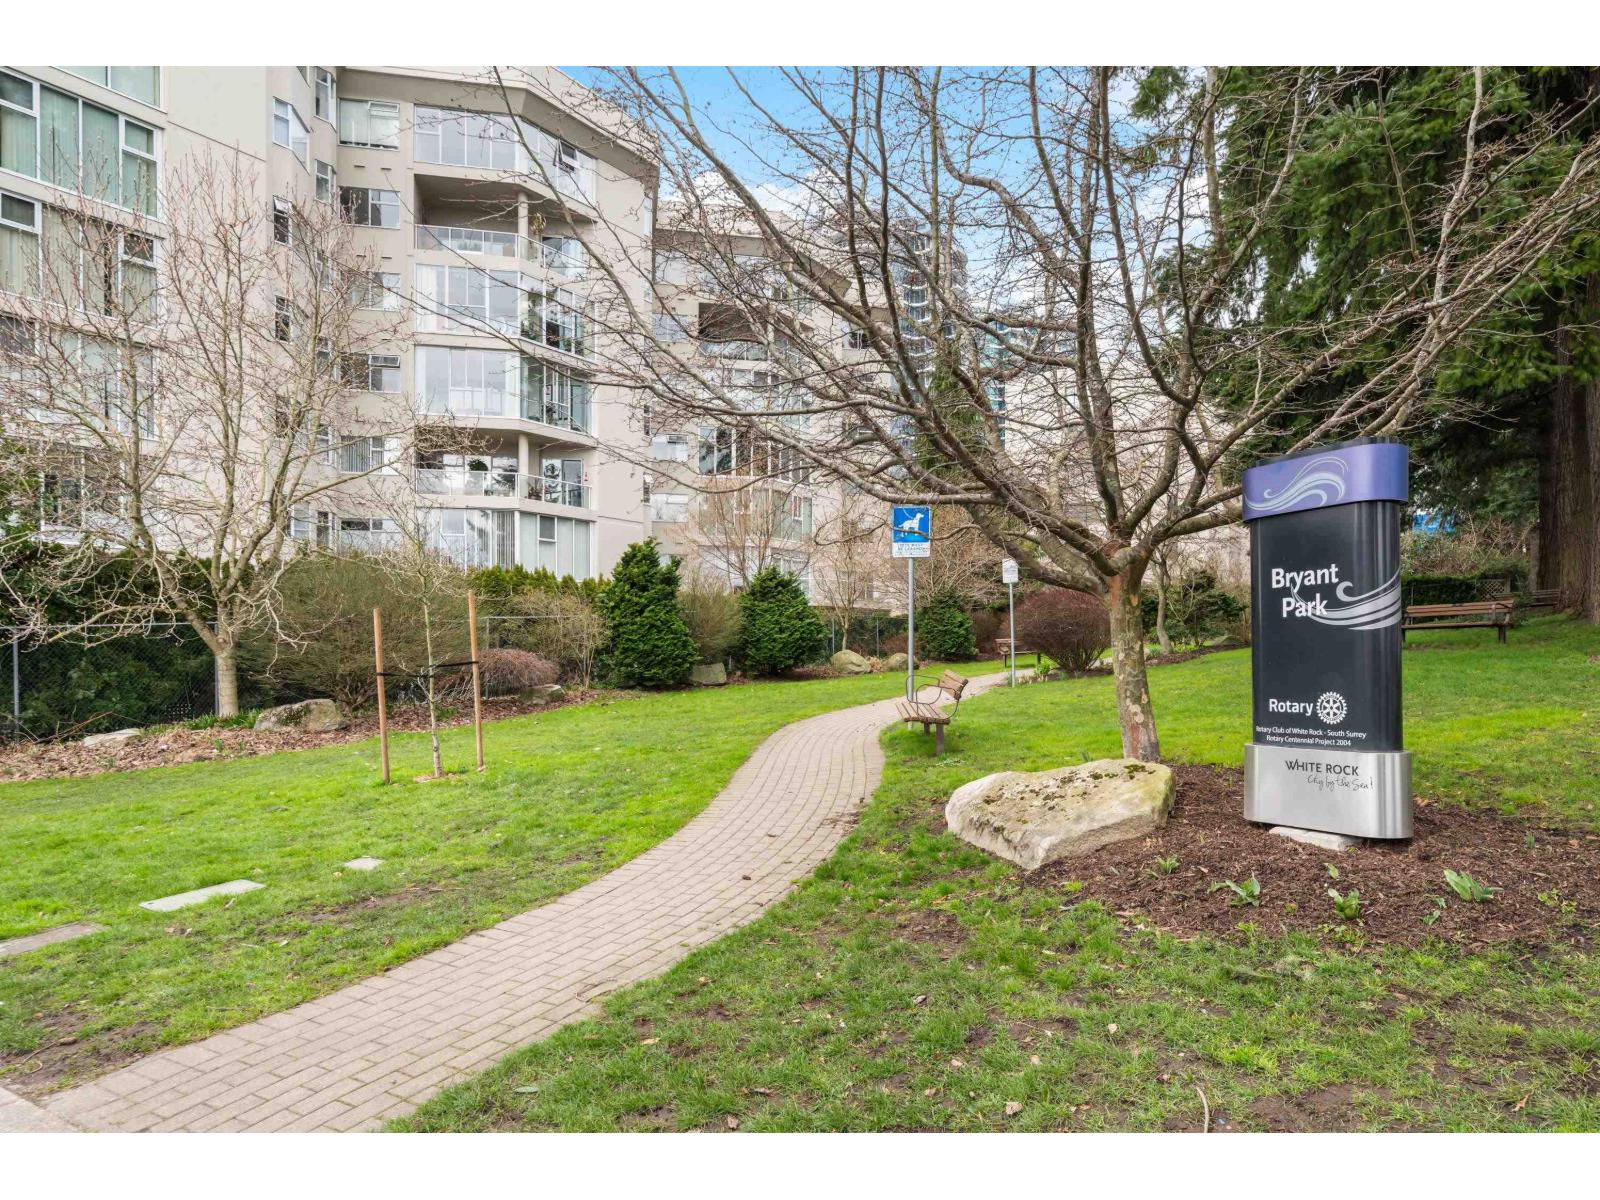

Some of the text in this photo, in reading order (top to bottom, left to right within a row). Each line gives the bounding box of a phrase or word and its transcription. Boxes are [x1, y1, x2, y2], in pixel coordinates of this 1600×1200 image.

[1272, 564, 1339, 593] Bryant
[1282, 593, 1328, 618] Park
[1269, 698, 1314, 716] Rotary
[1266, 735, 1284, 743] Rotary
[1284, 736, 1314, 744] Centennial
[1314, 738, 1335, 747] Project
[1309, 728, 1323, 736] Rock
[1346, 731, 1367, 740] Surrey
[1285, 759, 1359, 776] WHITE ROCK
[1307, 775, 1324, 791] City
[1325, 775, 1335, 792] by
[1334, 776, 1350, 787] the
